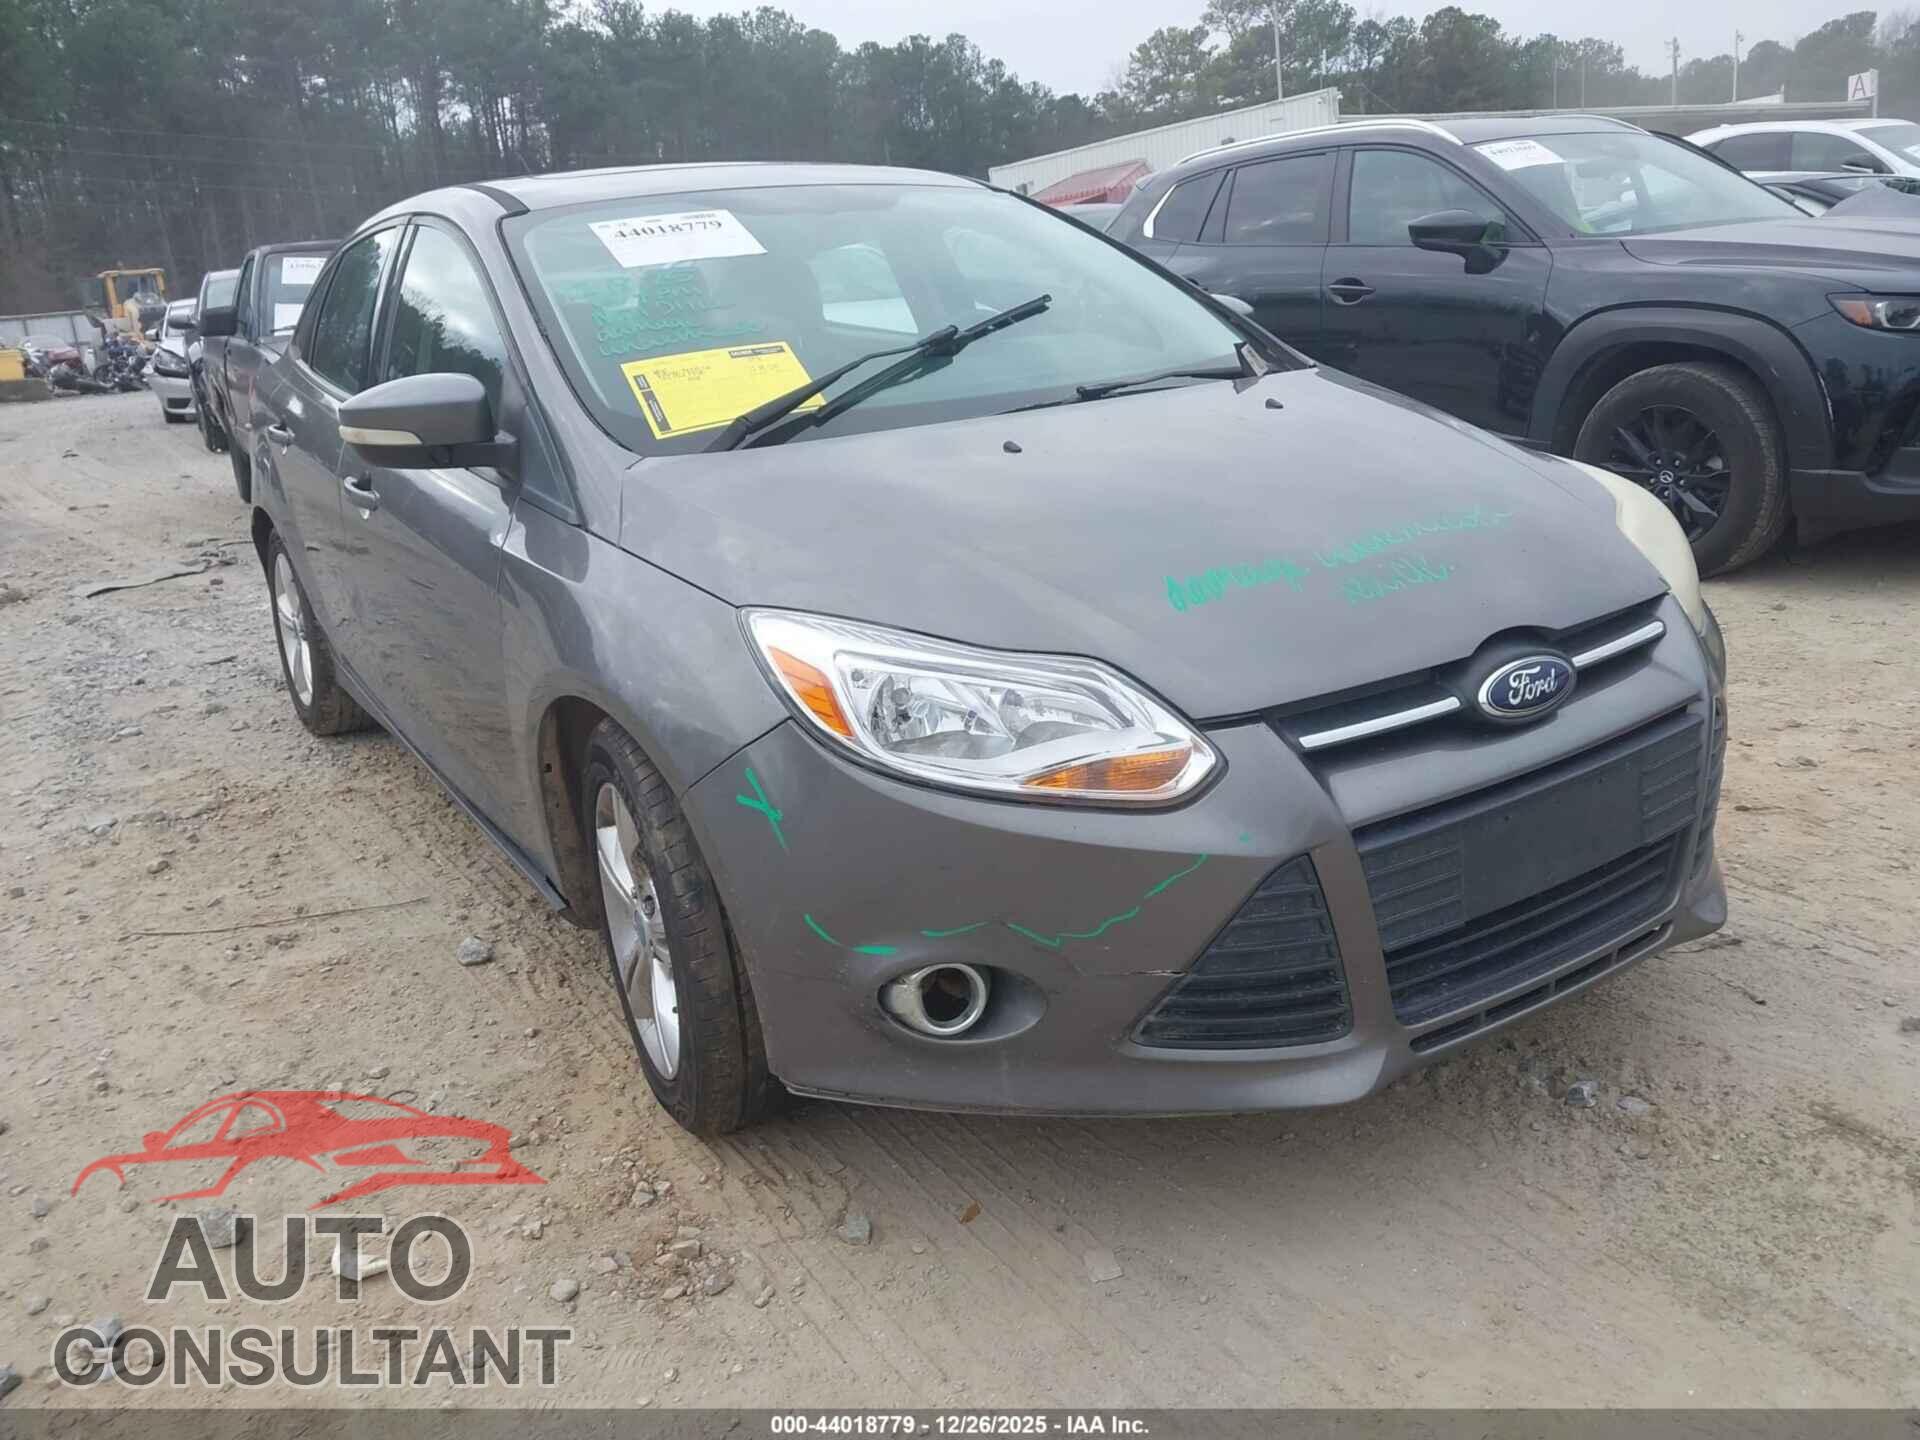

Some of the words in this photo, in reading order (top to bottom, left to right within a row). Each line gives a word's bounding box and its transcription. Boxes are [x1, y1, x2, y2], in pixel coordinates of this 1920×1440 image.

[1852, 74, 1866, 98] A
[613, 220, 723, 239] 44018779
[1508, 666, 1558, 705] Ford
